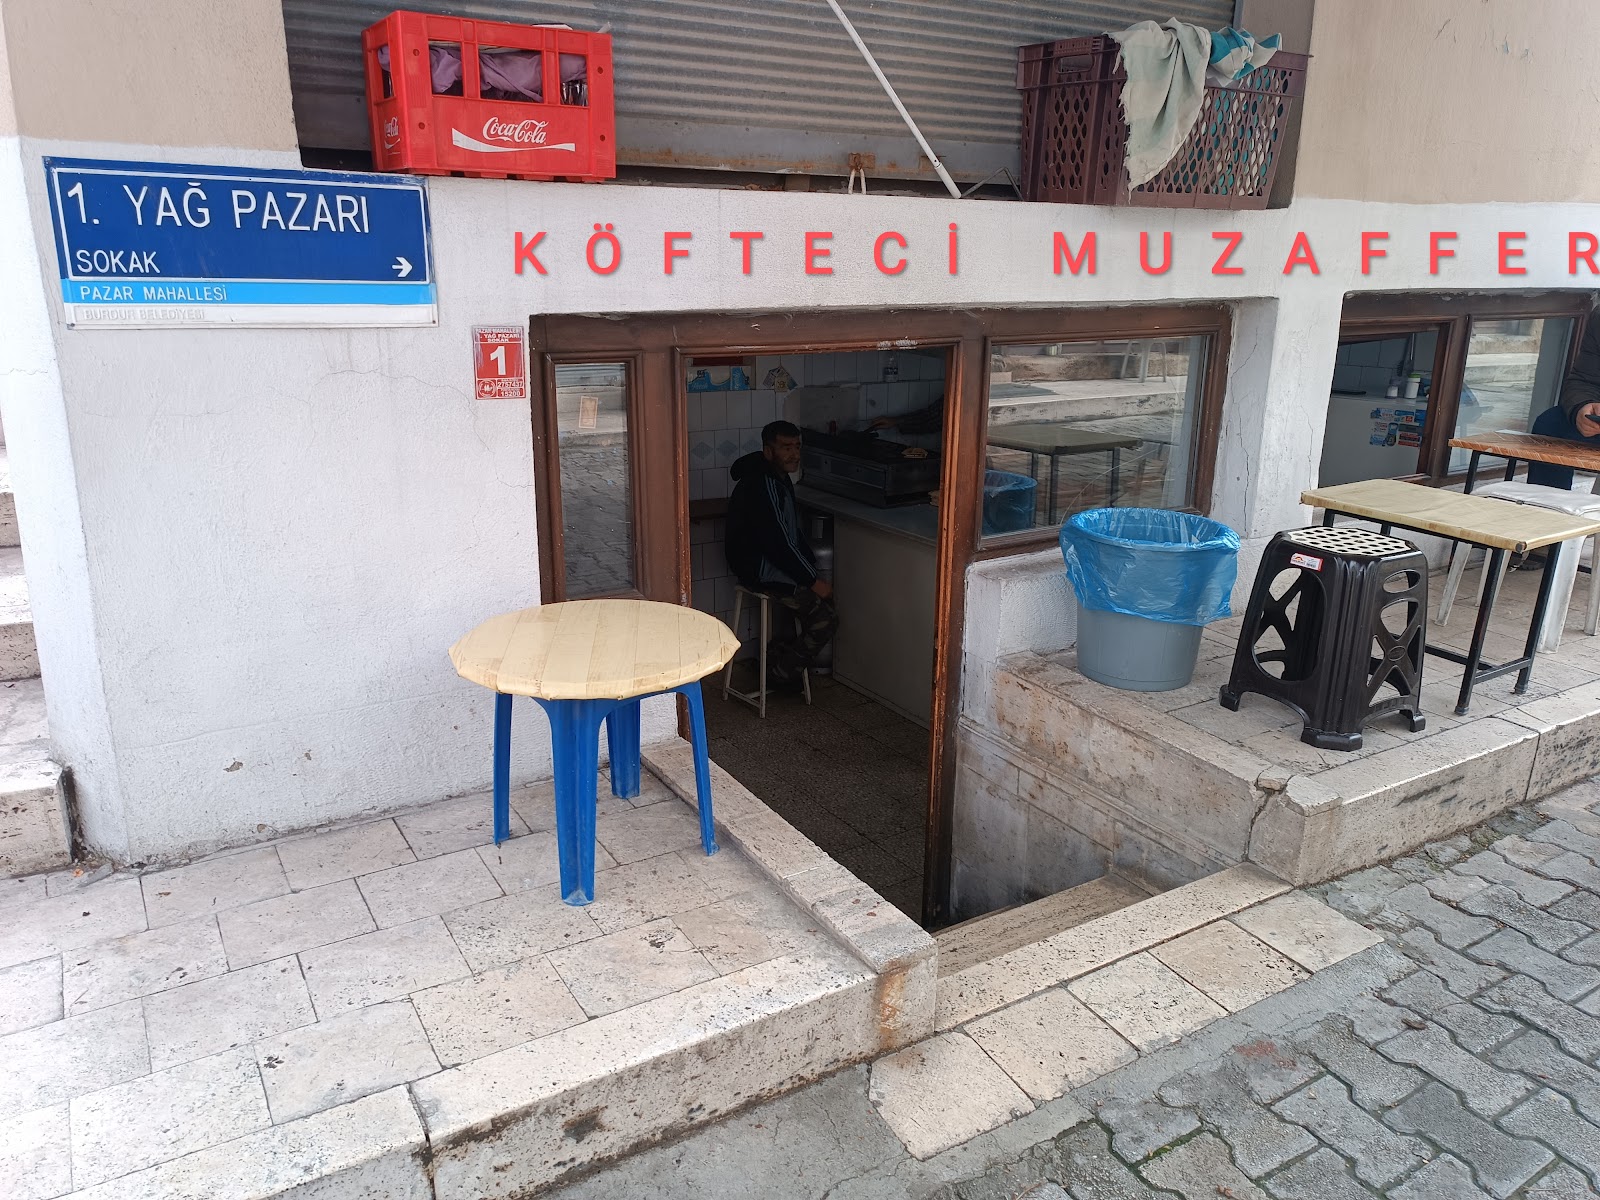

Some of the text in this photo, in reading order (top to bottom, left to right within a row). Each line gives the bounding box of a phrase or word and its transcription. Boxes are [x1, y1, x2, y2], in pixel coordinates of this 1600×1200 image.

[482, 116, 549, 145] Coca-Cola
[67, 182, 370, 234] 1. YAĞ PAZARI
[76, 249, 161, 274] SOKAK
[80, 285, 228, 301] PAZAR MAHALLESİ
[83, 308, 136, 321] BURDUR
[490, 346, 506, 375] 1
